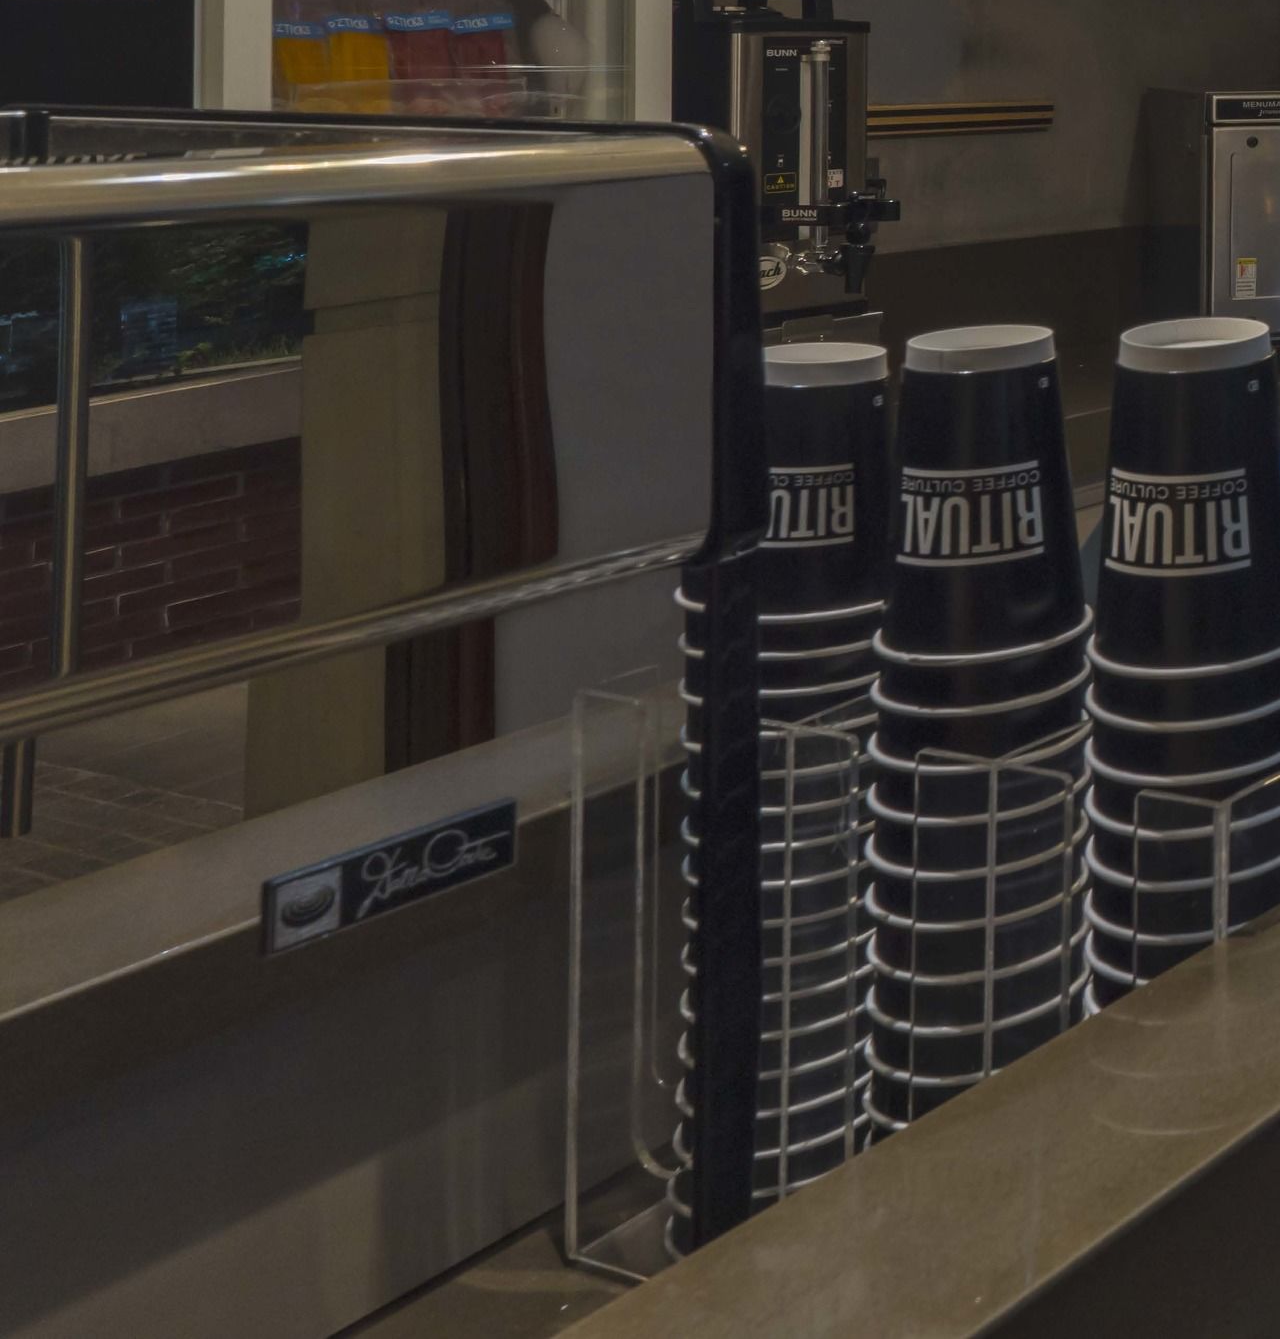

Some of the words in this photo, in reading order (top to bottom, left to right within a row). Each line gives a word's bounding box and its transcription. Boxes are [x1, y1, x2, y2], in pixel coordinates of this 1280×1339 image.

[766, 49, 797, 57] BUNN
[782, 209, 817, 218] BUNN
[902, 475, 965, 493] CULTURE
[972, 470, 1041, 492] COFFEE
[1110, 476, 1169, 500] CULTURE
[1175, 478, 1247, 500] COFFEE
[901, 486, 1044, 555] RITUAL
[1110, 495, 1252, 564] RITUAL
